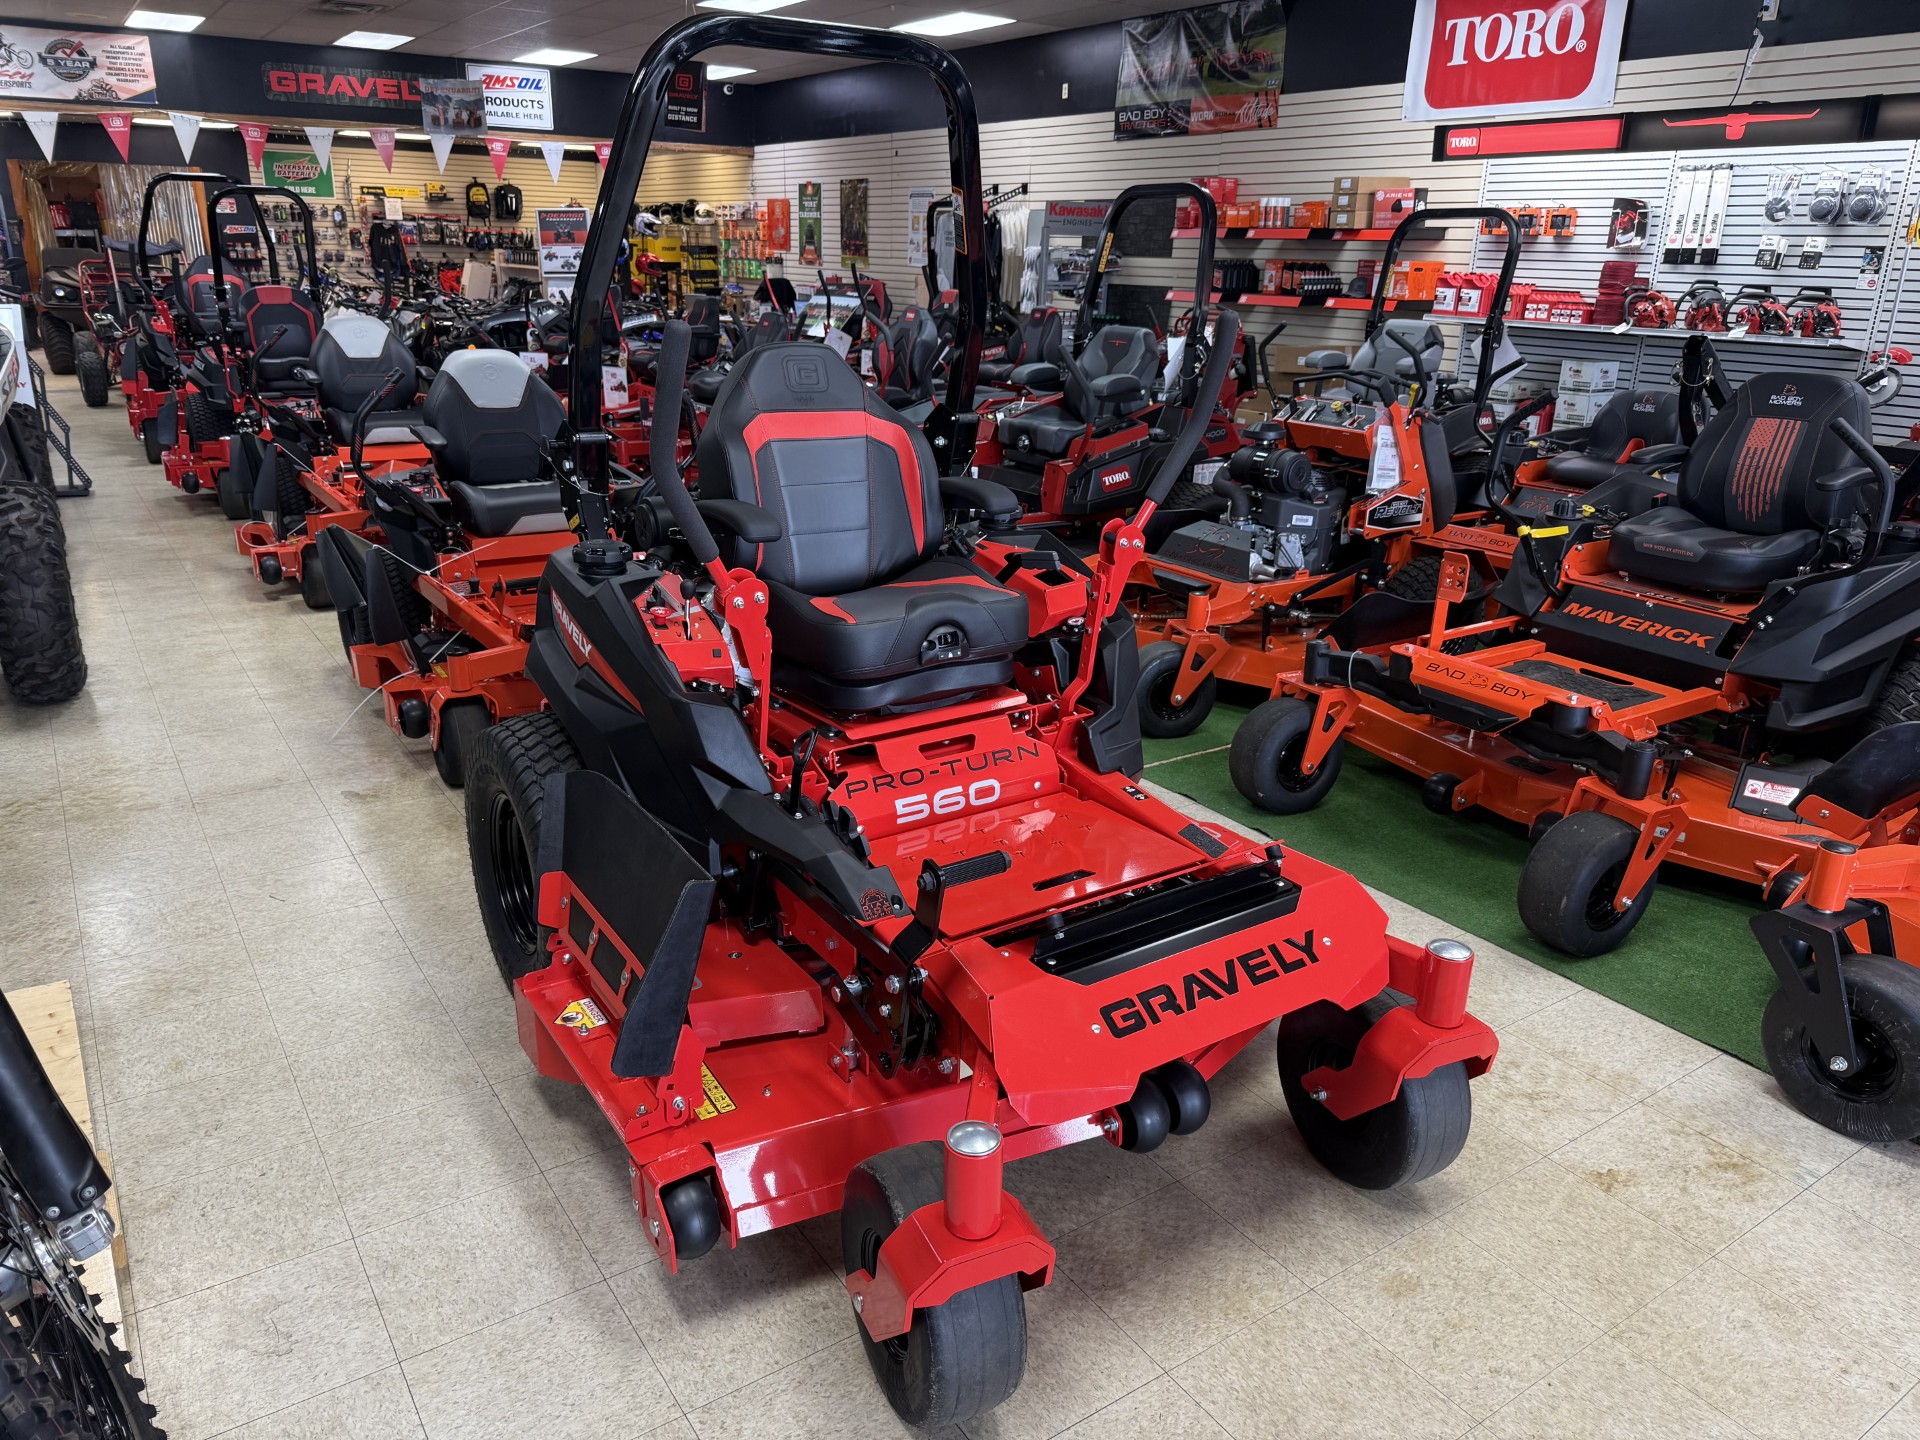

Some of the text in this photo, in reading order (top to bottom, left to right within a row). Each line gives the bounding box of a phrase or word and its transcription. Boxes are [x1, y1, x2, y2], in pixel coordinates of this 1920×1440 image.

[1445, 3, 1577, 66] TORO
[46, 58, 90, 68] 5 YEAR
[482, 73, 544, 92] AMSOIL
[485, 96, 545, 110] RODUCTS
[523, 112, 544, 121] HERE
[667, 113, 698, 123] DISTANCE
[1119, 108, 1167, 122] BAD BOY
[1190, 111, 1214, 122] WORK
[1450, 136, 1477, 149] TORO
[275, 164, 320, 172] INTERSTATE
[277, 170, 317, 178] BATTERIES
[1049, 202, 1110, 218] Kawasaki
[226, 225, 256, 234] AMSOIL
[1062, 219, 1092, 227] ENGINES
[1674, 214, 1685, 235] RedMax
[1691, 213, 1701, 234] RedMax
[1709, 212, 1719, 234] RedMax
[1478, 417, 1492, 426] ORO
[1205, 429, 1225, 438] 4000
[1102, 469, 1130, 486] TORO
[1374, 504, 1422, 519] REVOLT
[1448, 530, 1515, 548] BAD BOY
[1672, 548, 1694, 557] ATTITUDE
[552, 590, 592, 657] GRAVELY
[1563, 602, 1715, 649] MAVERICK
[1425, 662, 1536, 700] BAD BOY
[845, 743, 1039, 799] PRO-TURN
[894, 779, 1001, 825] 560
[1099, 929, 1321, 1039] GRAVELY
[583, 1000, 604, 1023] DANGER
